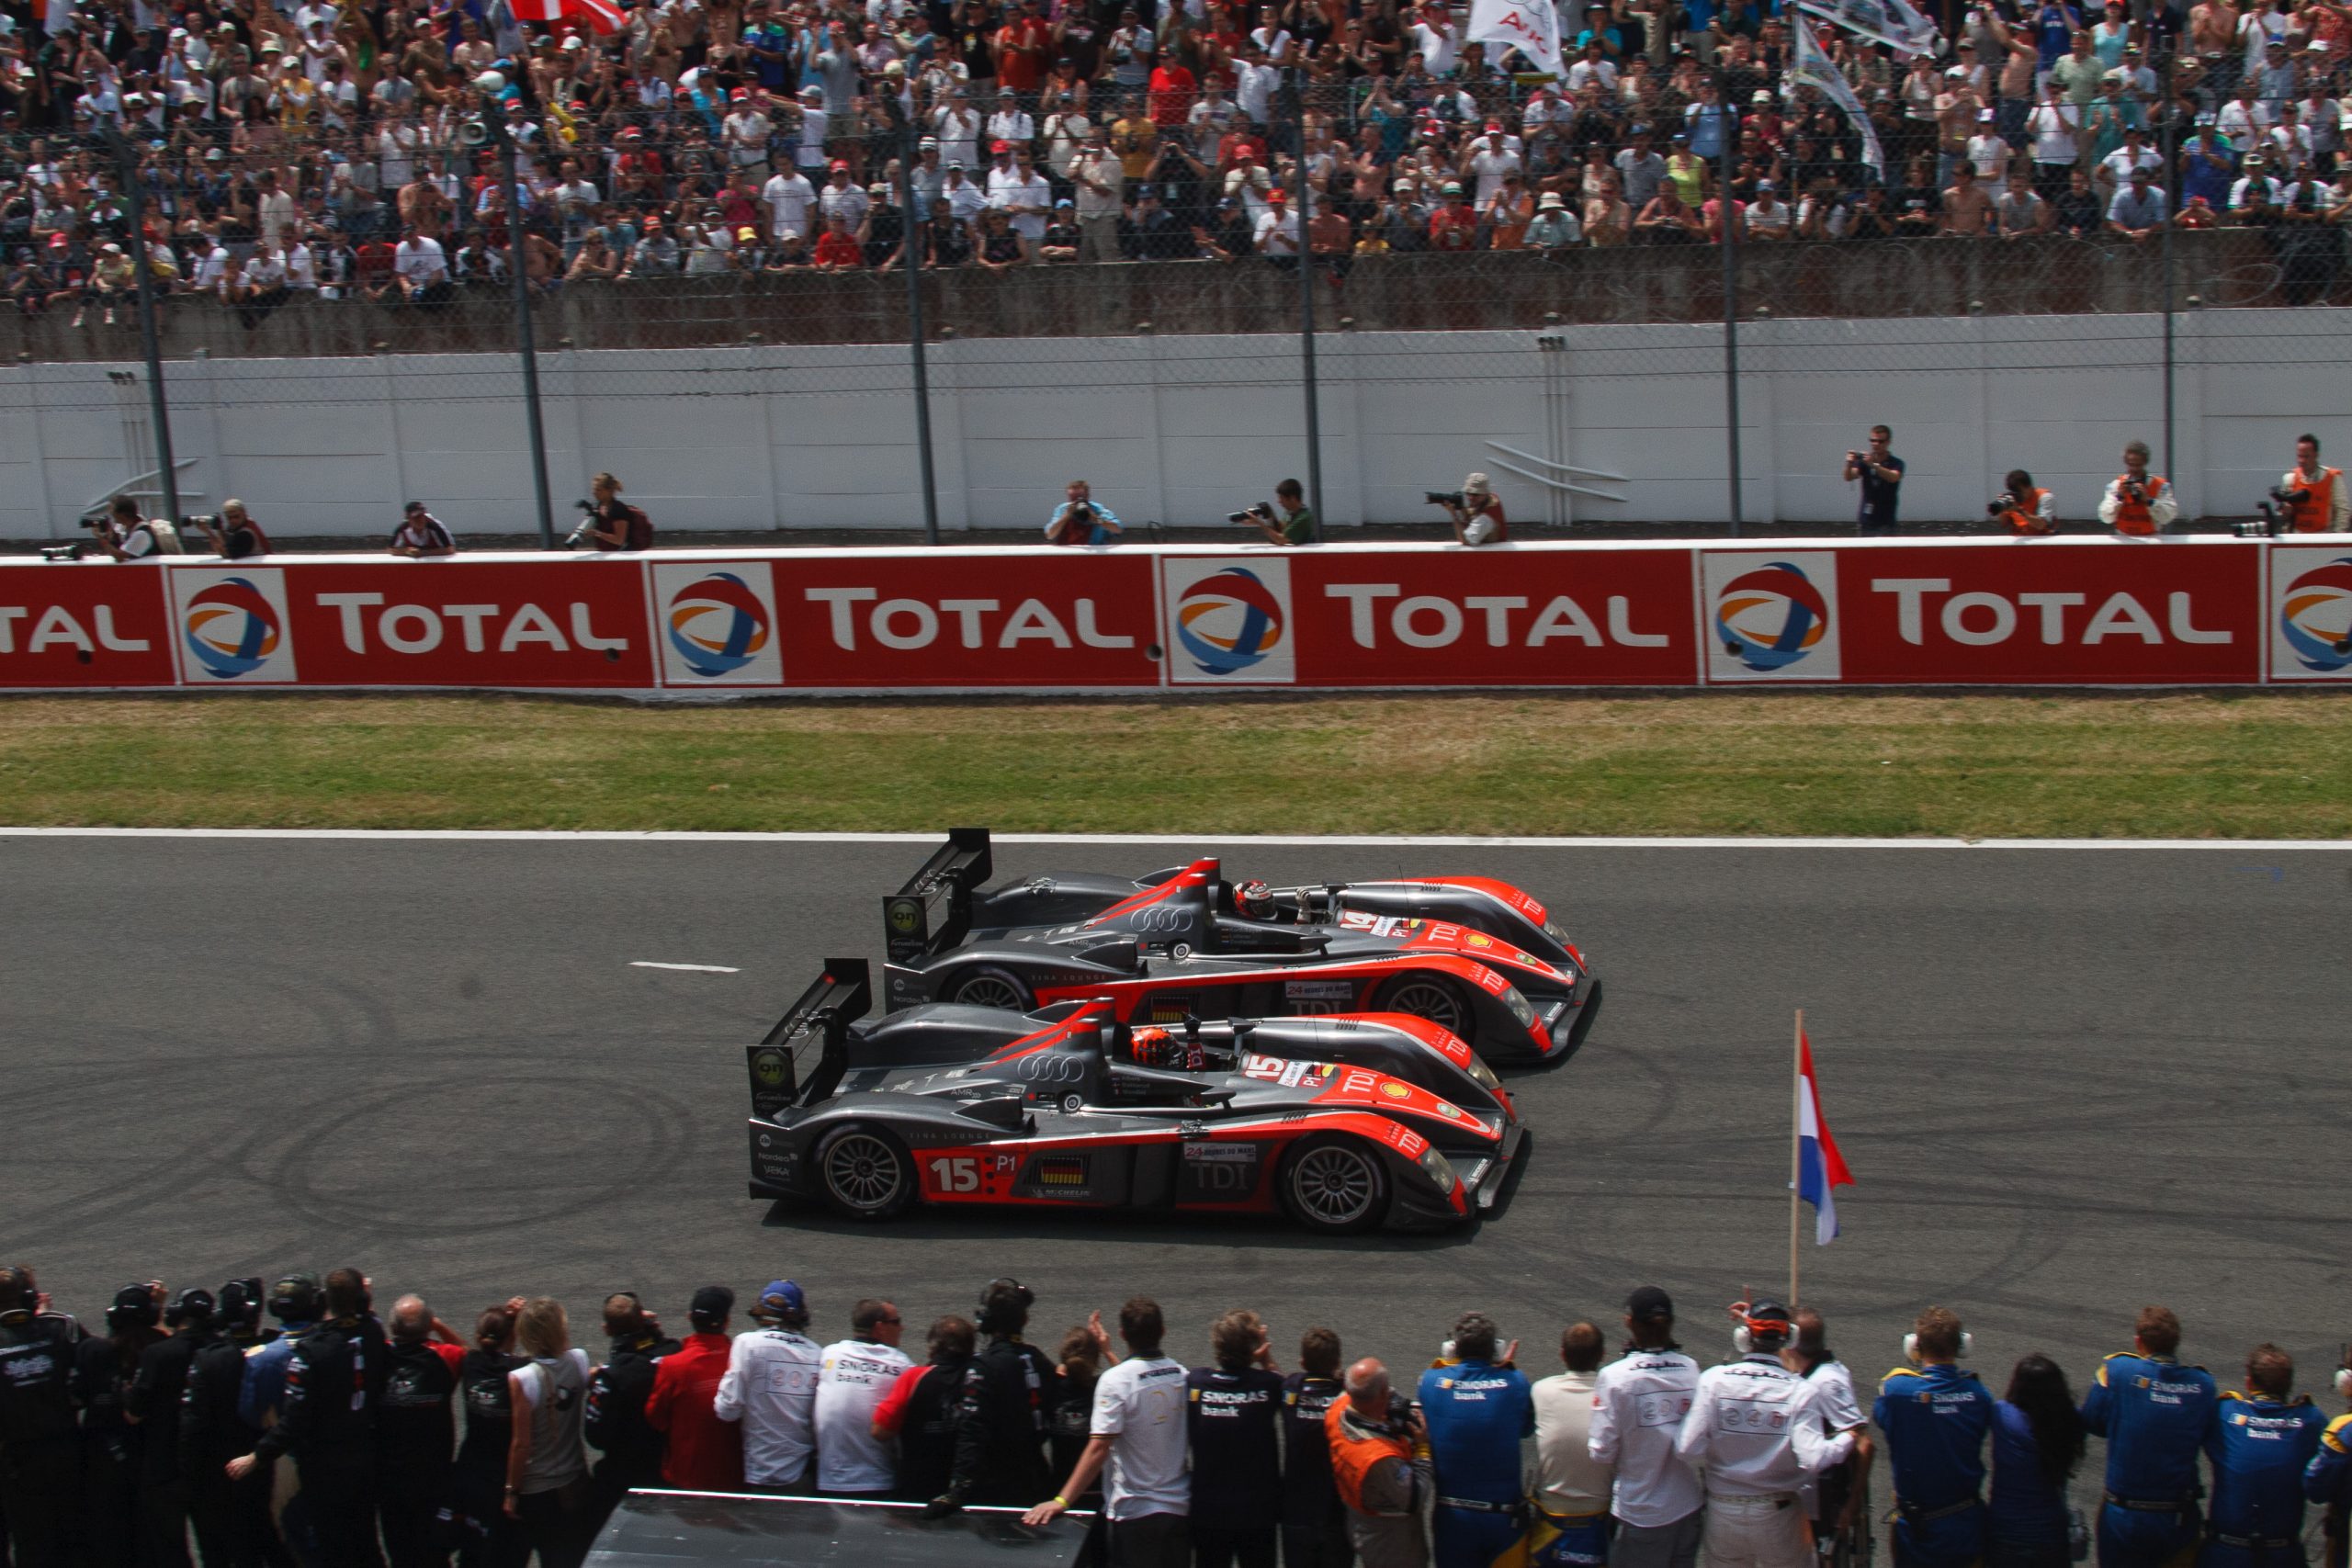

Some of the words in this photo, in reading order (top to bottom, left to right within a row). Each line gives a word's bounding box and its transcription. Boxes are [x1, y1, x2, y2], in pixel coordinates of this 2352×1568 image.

[805, 587, 1134, 651] TOTAL
[1325, 583, 1668, 649] TOTAL
[1871, 578, 2232, 646] TOTAL
[318, 592, 628, 654] TOTAL
[1523, 897, 1543, 916] TDI
[1340, 911, 1378, 930] 14
[1392, 928, 1409, 938] P1
[1428, 922, 1461, 942] TDI
[1482, 969, 1505, 991] TDI
[1288, 986, 1303, 995] 24
[1445, 1036, 1468, 1056] TDI
[1245, 1055, 1284, 1077] 15
[1303, 1076, 1322, 1088] P1
[1341, 1070, 1380, 1093] TDI
[1186, 1146, 1204, 1156] 24
[1397, 1128, 1424, 1154] TDI
[758, 1152, 790, 1162] Nordea
[997, 1155, 1016, 1172] P1
[930, 1157, 979, 1193] 15
[1189, 1161, 1249, 1190] TDI
[1201, 1391, 1269, 1404] SNORAS
[1453, 1391, 1487, 1401] bank
[1201, 1404, 1240, 1417] bank
